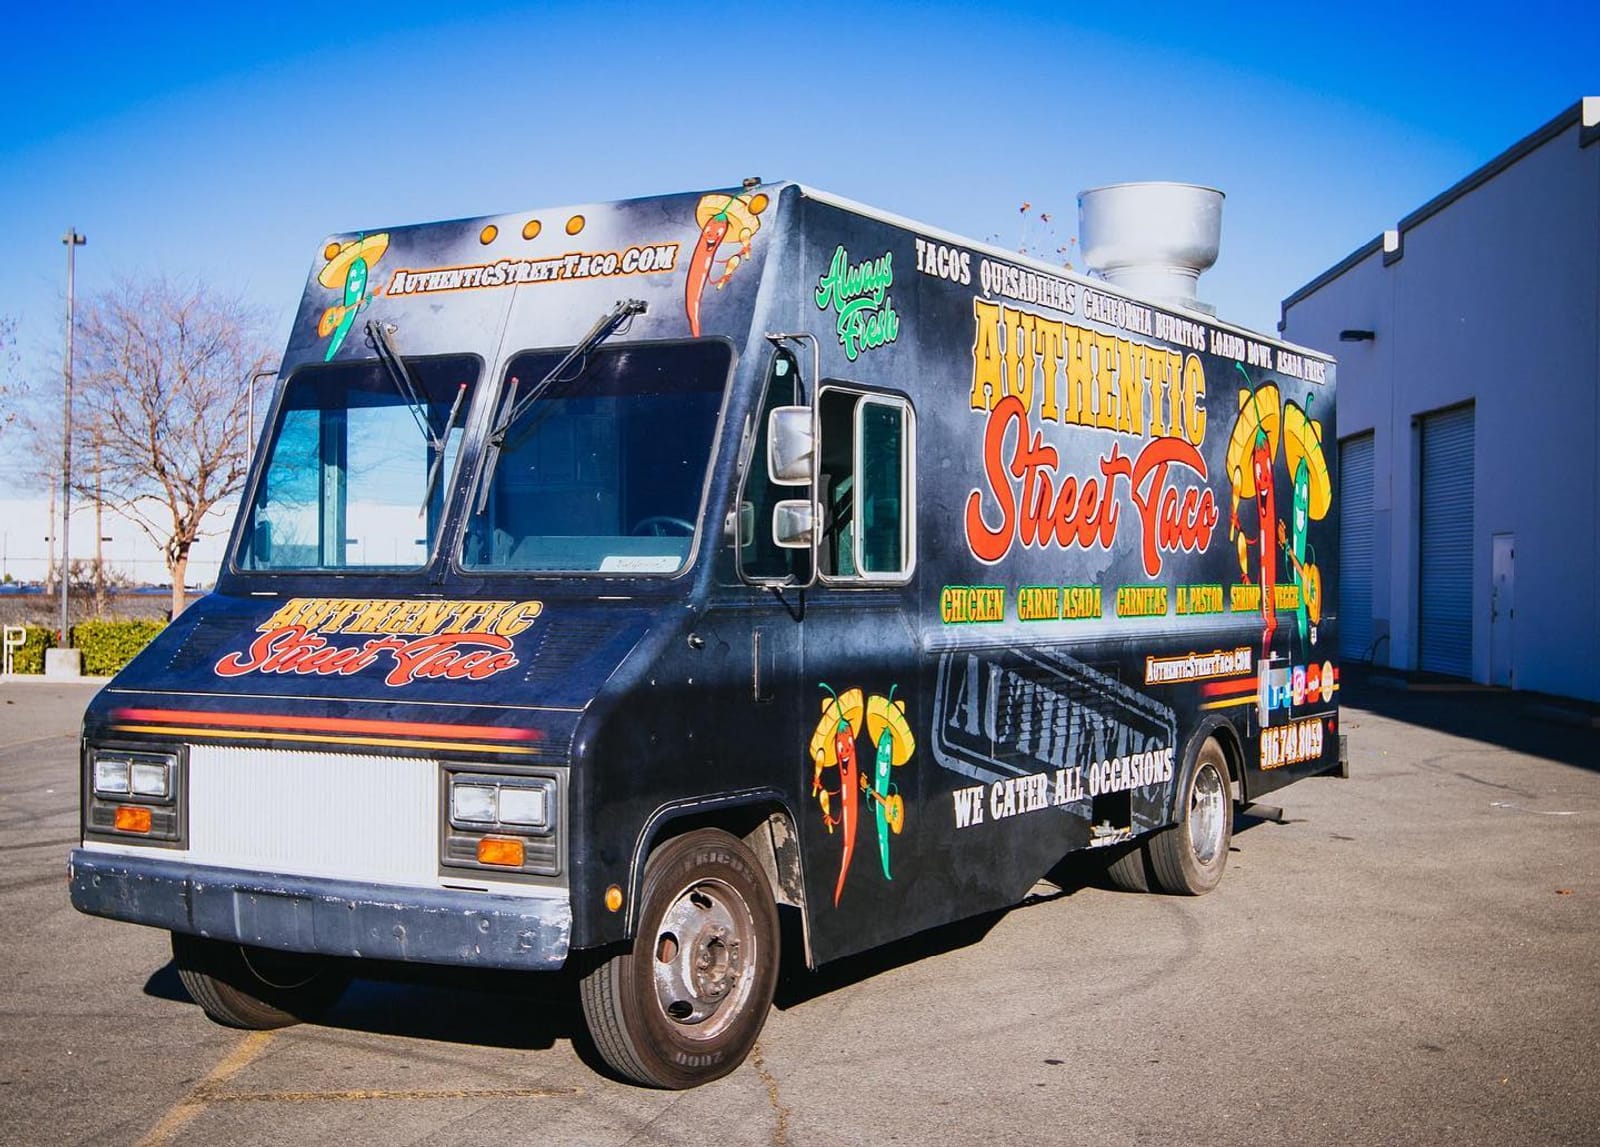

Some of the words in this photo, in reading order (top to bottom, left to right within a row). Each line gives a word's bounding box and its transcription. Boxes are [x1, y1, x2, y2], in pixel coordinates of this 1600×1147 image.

[815, 245, 893, 312] Always
[915, 238, 971, 286] TACOS
[980, 259, 1076, 315] QUESADILLAS
[1083, 289, 1152, 337] CALIFORNIA
[1154, 312, 1206, 352] BURRITOS
[1210, 330, 1246, 362] LOADED
[1247, 341, 1272, 369] BOWL
[1276, 351, 1303, 380] ASADA
[1303, 358, 1326, 386] FRIES
[837, 297, 899, 360] Fresh
[970, 296, 1207, 447] AUTHENTIC
[965, 394, 1132, 565] Street
[1131, 435, 1218, 578] Taco
[256, 598, 543, 636] AUTHENTIC
[941, 586, 1005, 625] CHICKEN
[1017, 586, 1059, 621] CARNE
[1061, 586, 1102, 619] ASADA
[1116, 585, 1168, 618] CARNITAS
[1188, 585, 1224, 615] PASTOR
[1230, 585, 1261, 612] SHRIMP
[1274, 585, 1300, 610] VEGGIE
[214, 624, 406, 678] Street
[385, 633, 519, 687] Taco
[953, 785, 985, 829] WE
[990, 772, 1049, 821] CATER
[1054, 756, 1085, 806] ALL
[1088, 747, 1174, 797] OCCASIONS
